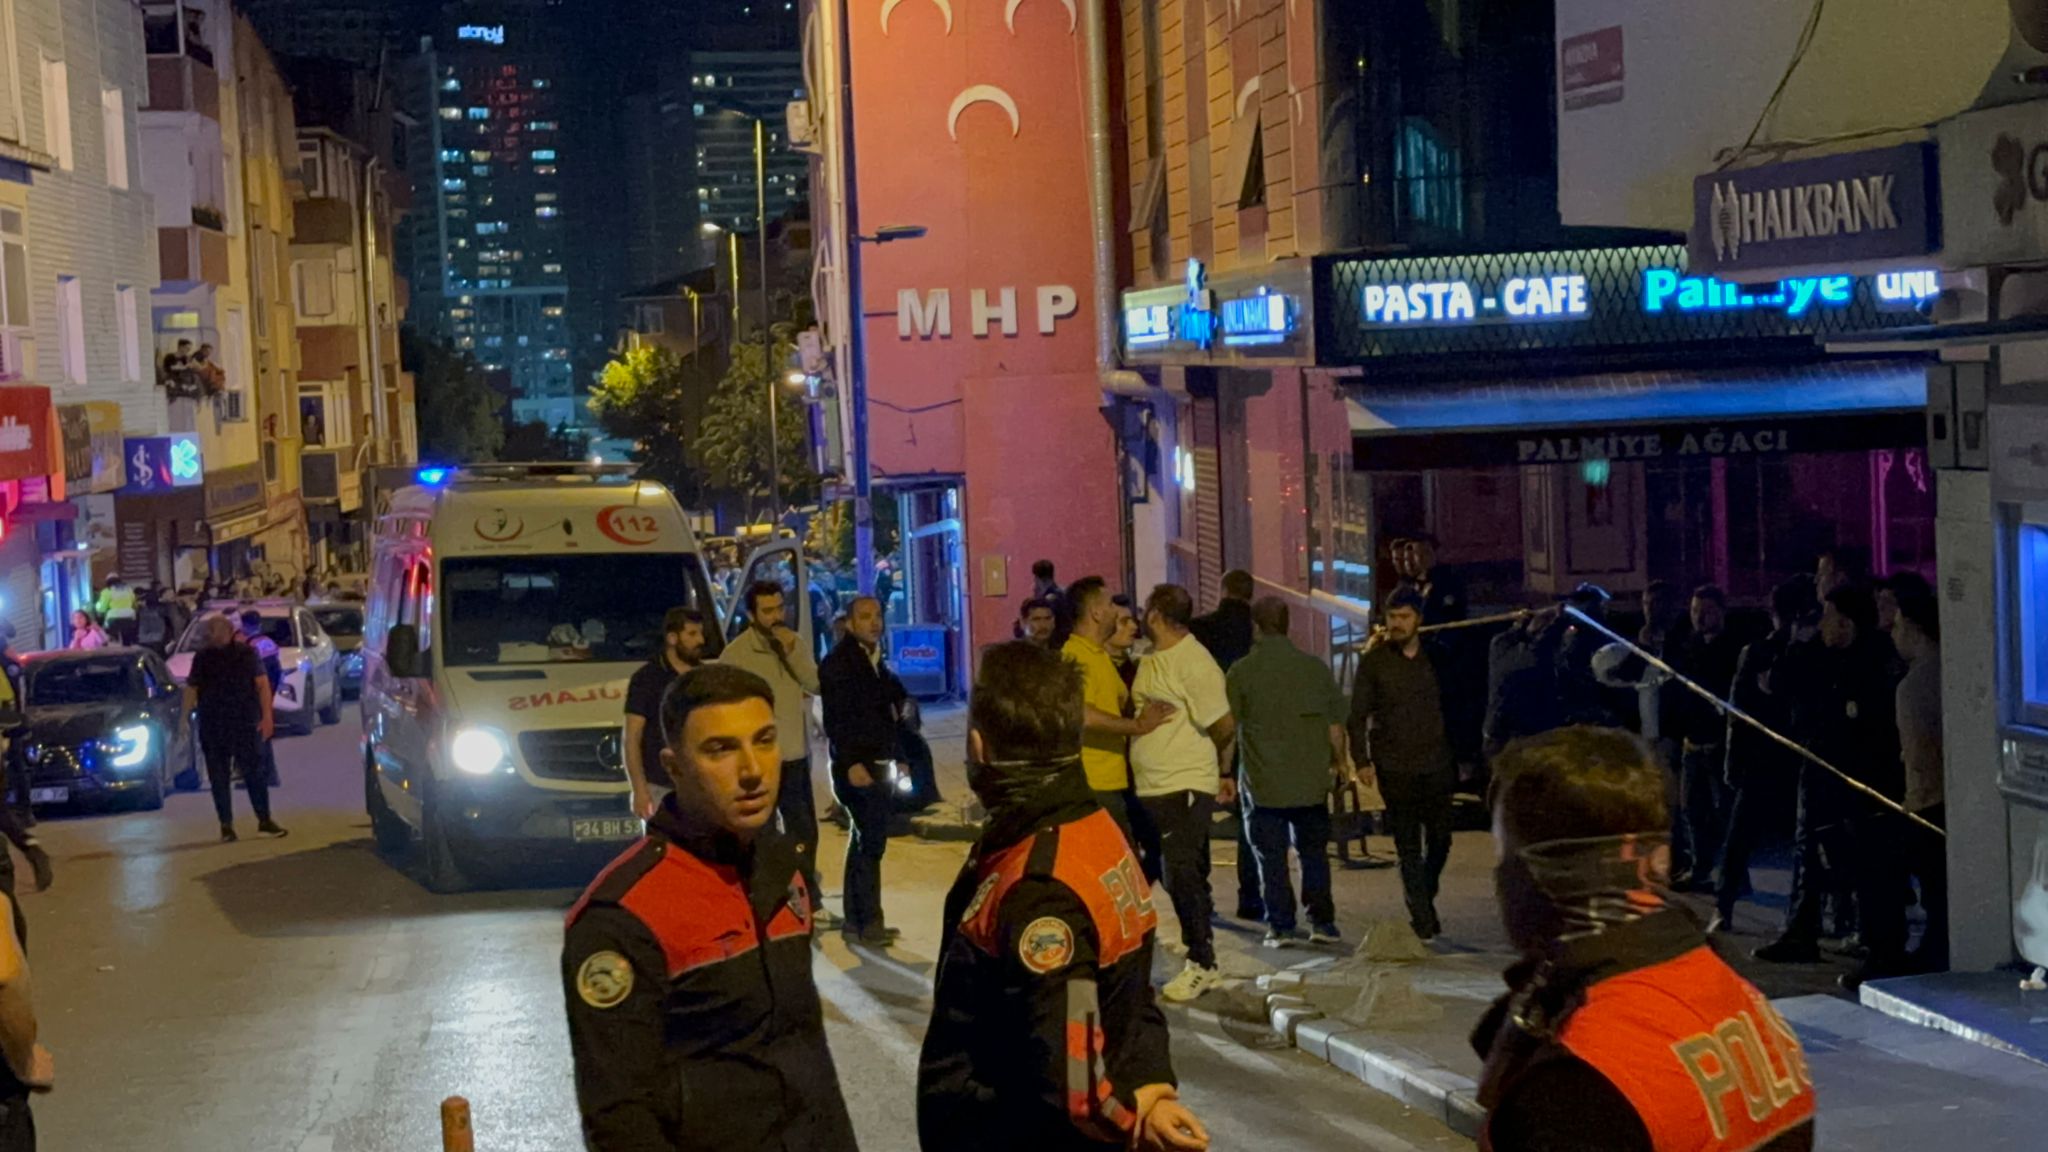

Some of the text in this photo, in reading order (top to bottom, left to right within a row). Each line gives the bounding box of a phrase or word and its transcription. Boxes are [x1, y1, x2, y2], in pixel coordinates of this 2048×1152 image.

[1742, 174, 1897, 244] HALKBANK
[897, 284, 1078, 338] MHP
[1365, 281, 1475, 322] PASTA
[1504, 275, 1587, 315] CAFE
[1646, 269, 1849, 314] Palye
[612, 515, 659, 533] 112
